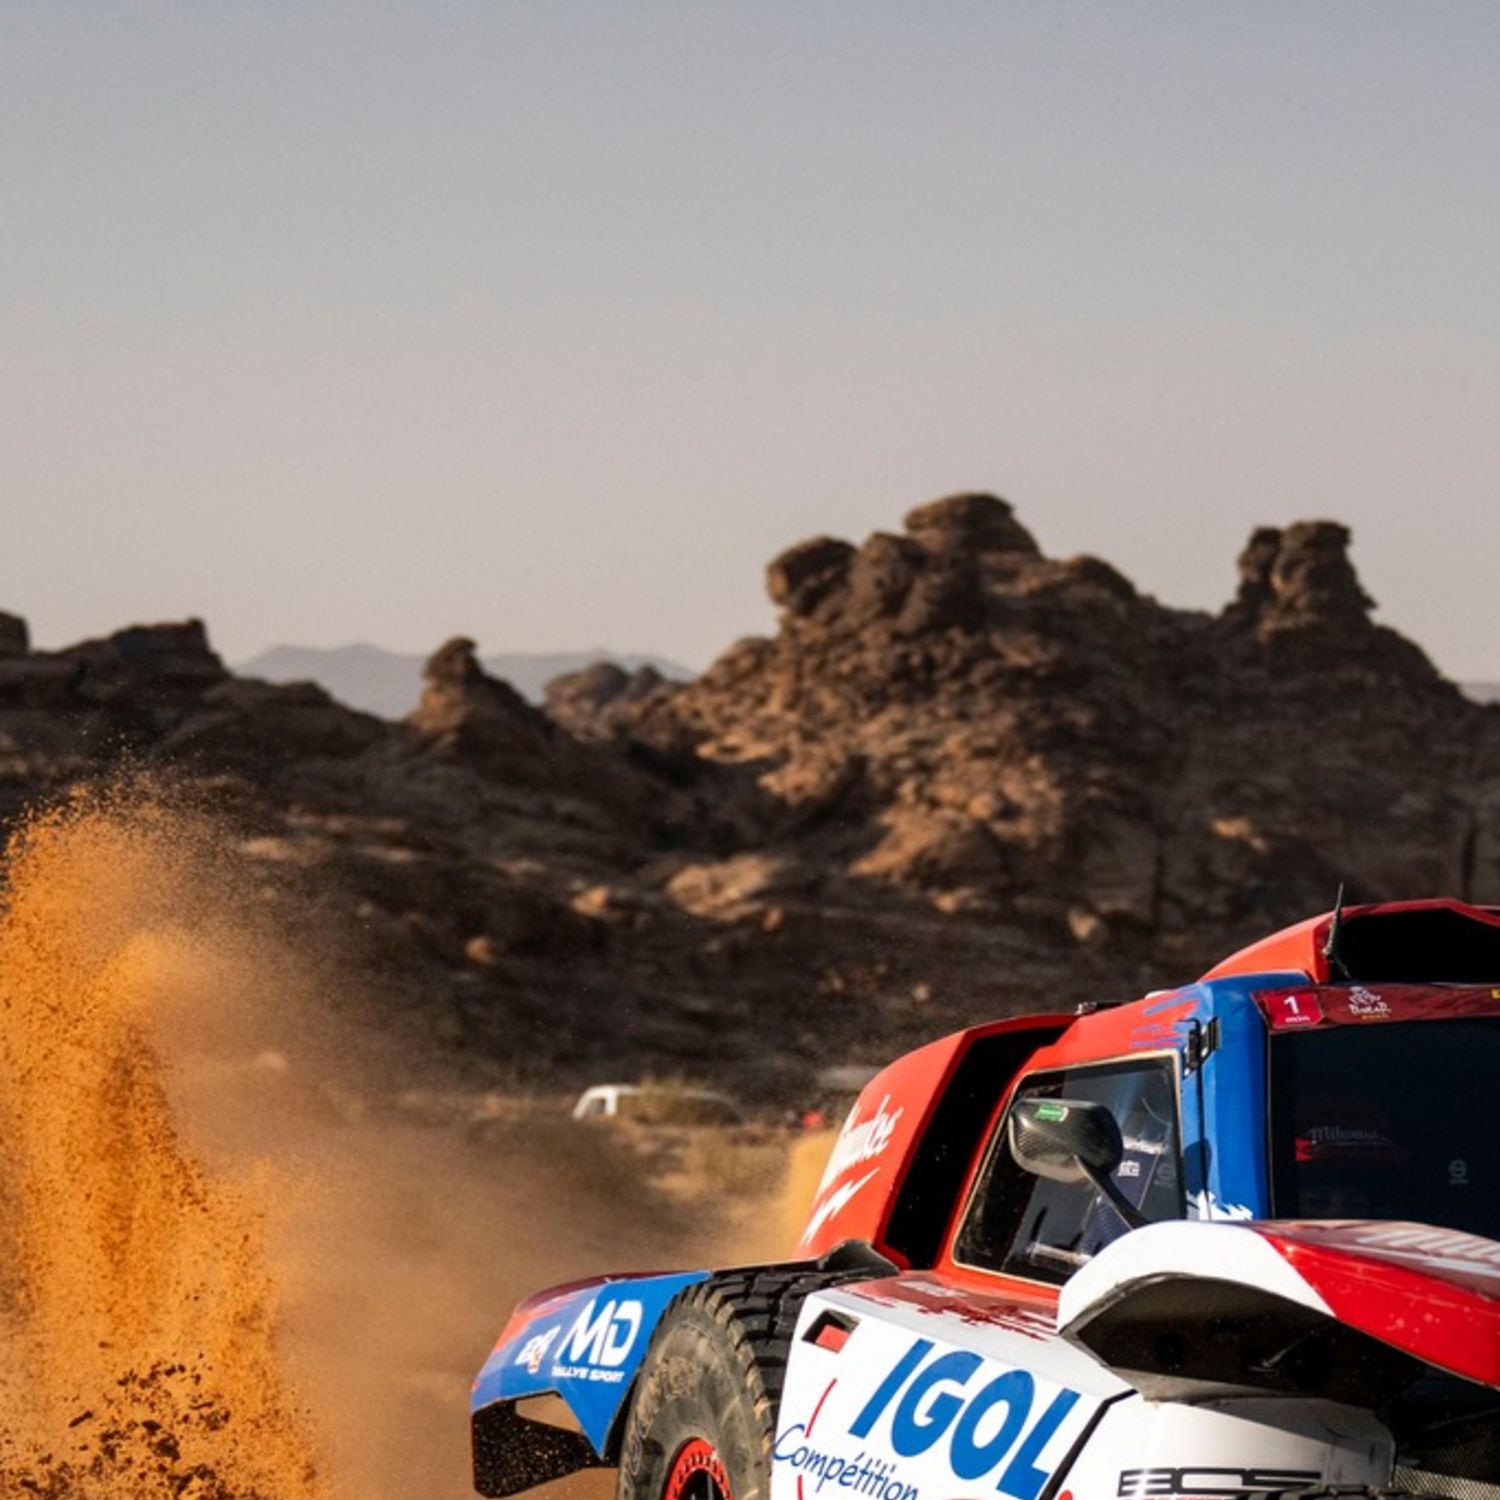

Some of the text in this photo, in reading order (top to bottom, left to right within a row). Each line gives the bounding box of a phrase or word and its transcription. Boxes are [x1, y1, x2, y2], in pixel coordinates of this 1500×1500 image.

[1283, 996, 1299, 1014] 1
[554, 1299, 643, 1367] MD
[588, 1370, 625, 1383] SPORT
